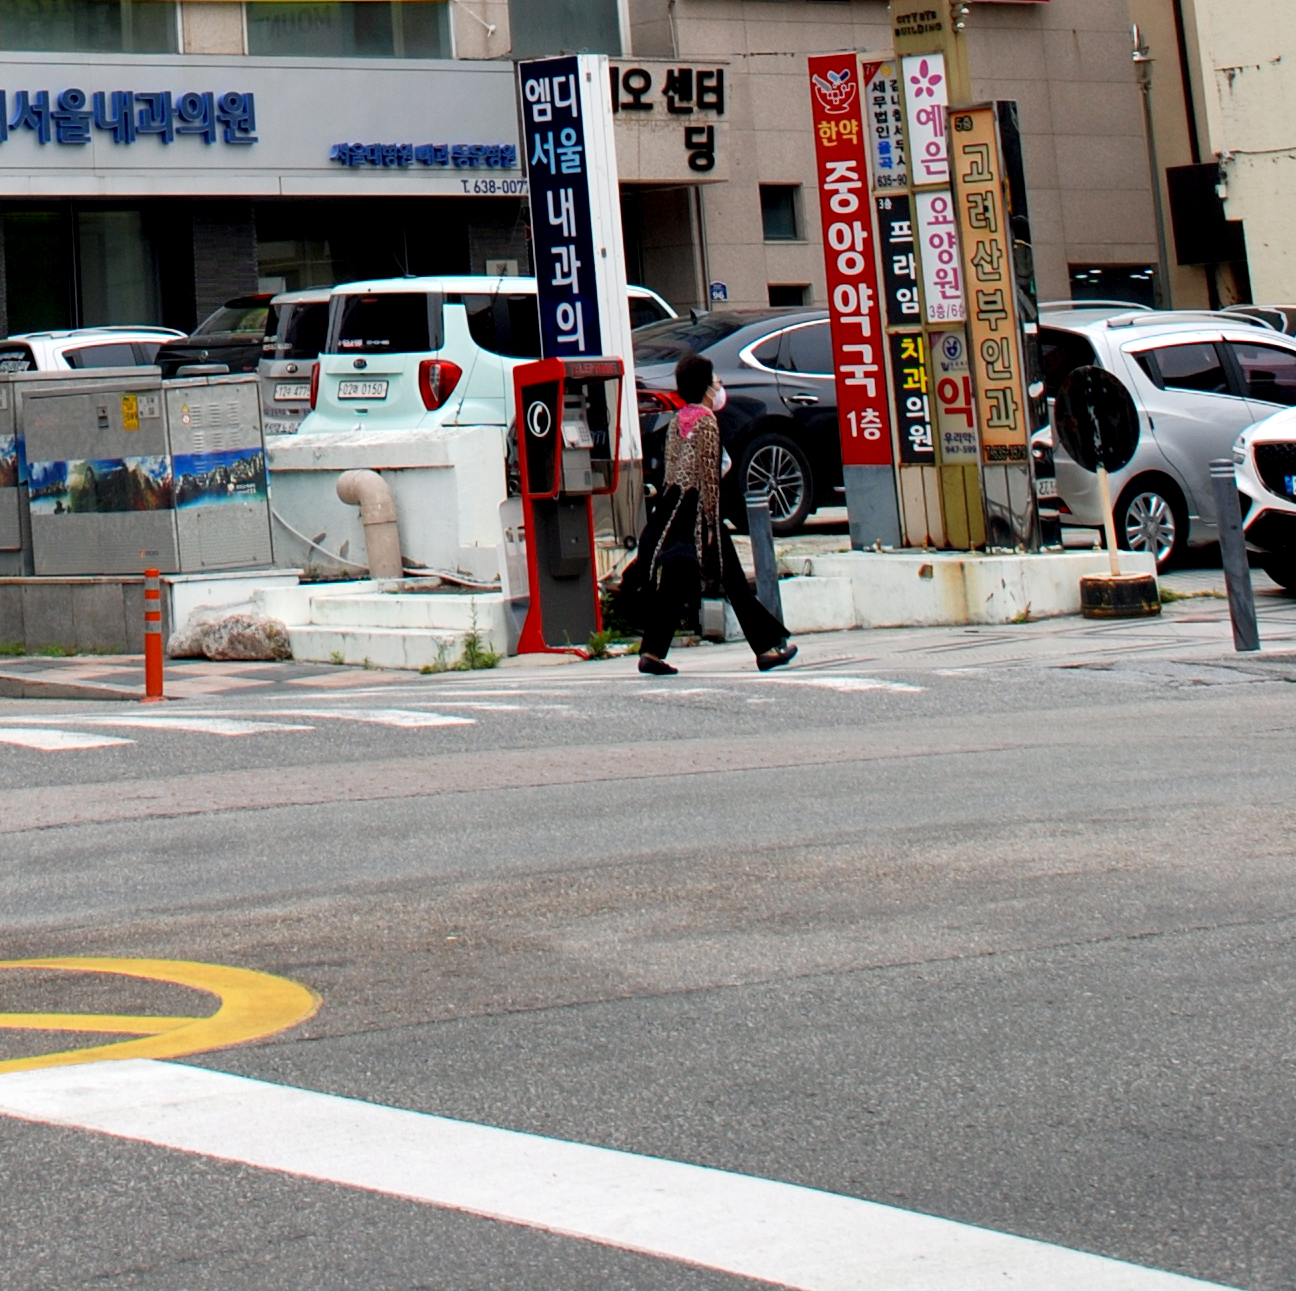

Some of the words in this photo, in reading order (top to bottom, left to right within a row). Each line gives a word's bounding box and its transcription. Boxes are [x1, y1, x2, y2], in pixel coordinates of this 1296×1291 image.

[525, 74, 579, 123] 엠디
[662, 68, 724, 115] 센터
[531, 127, 583, 175] 서울
[818, 119, 859, 148] 한약
[916, 104, 948, 176] 예은
[927, 196, 962, 300] 요양원
[823, 159, 879, 398] 중앙약국
[963, 142, 1019, 430] 고려산부인과
[846, 407, 884, 440] 1층
